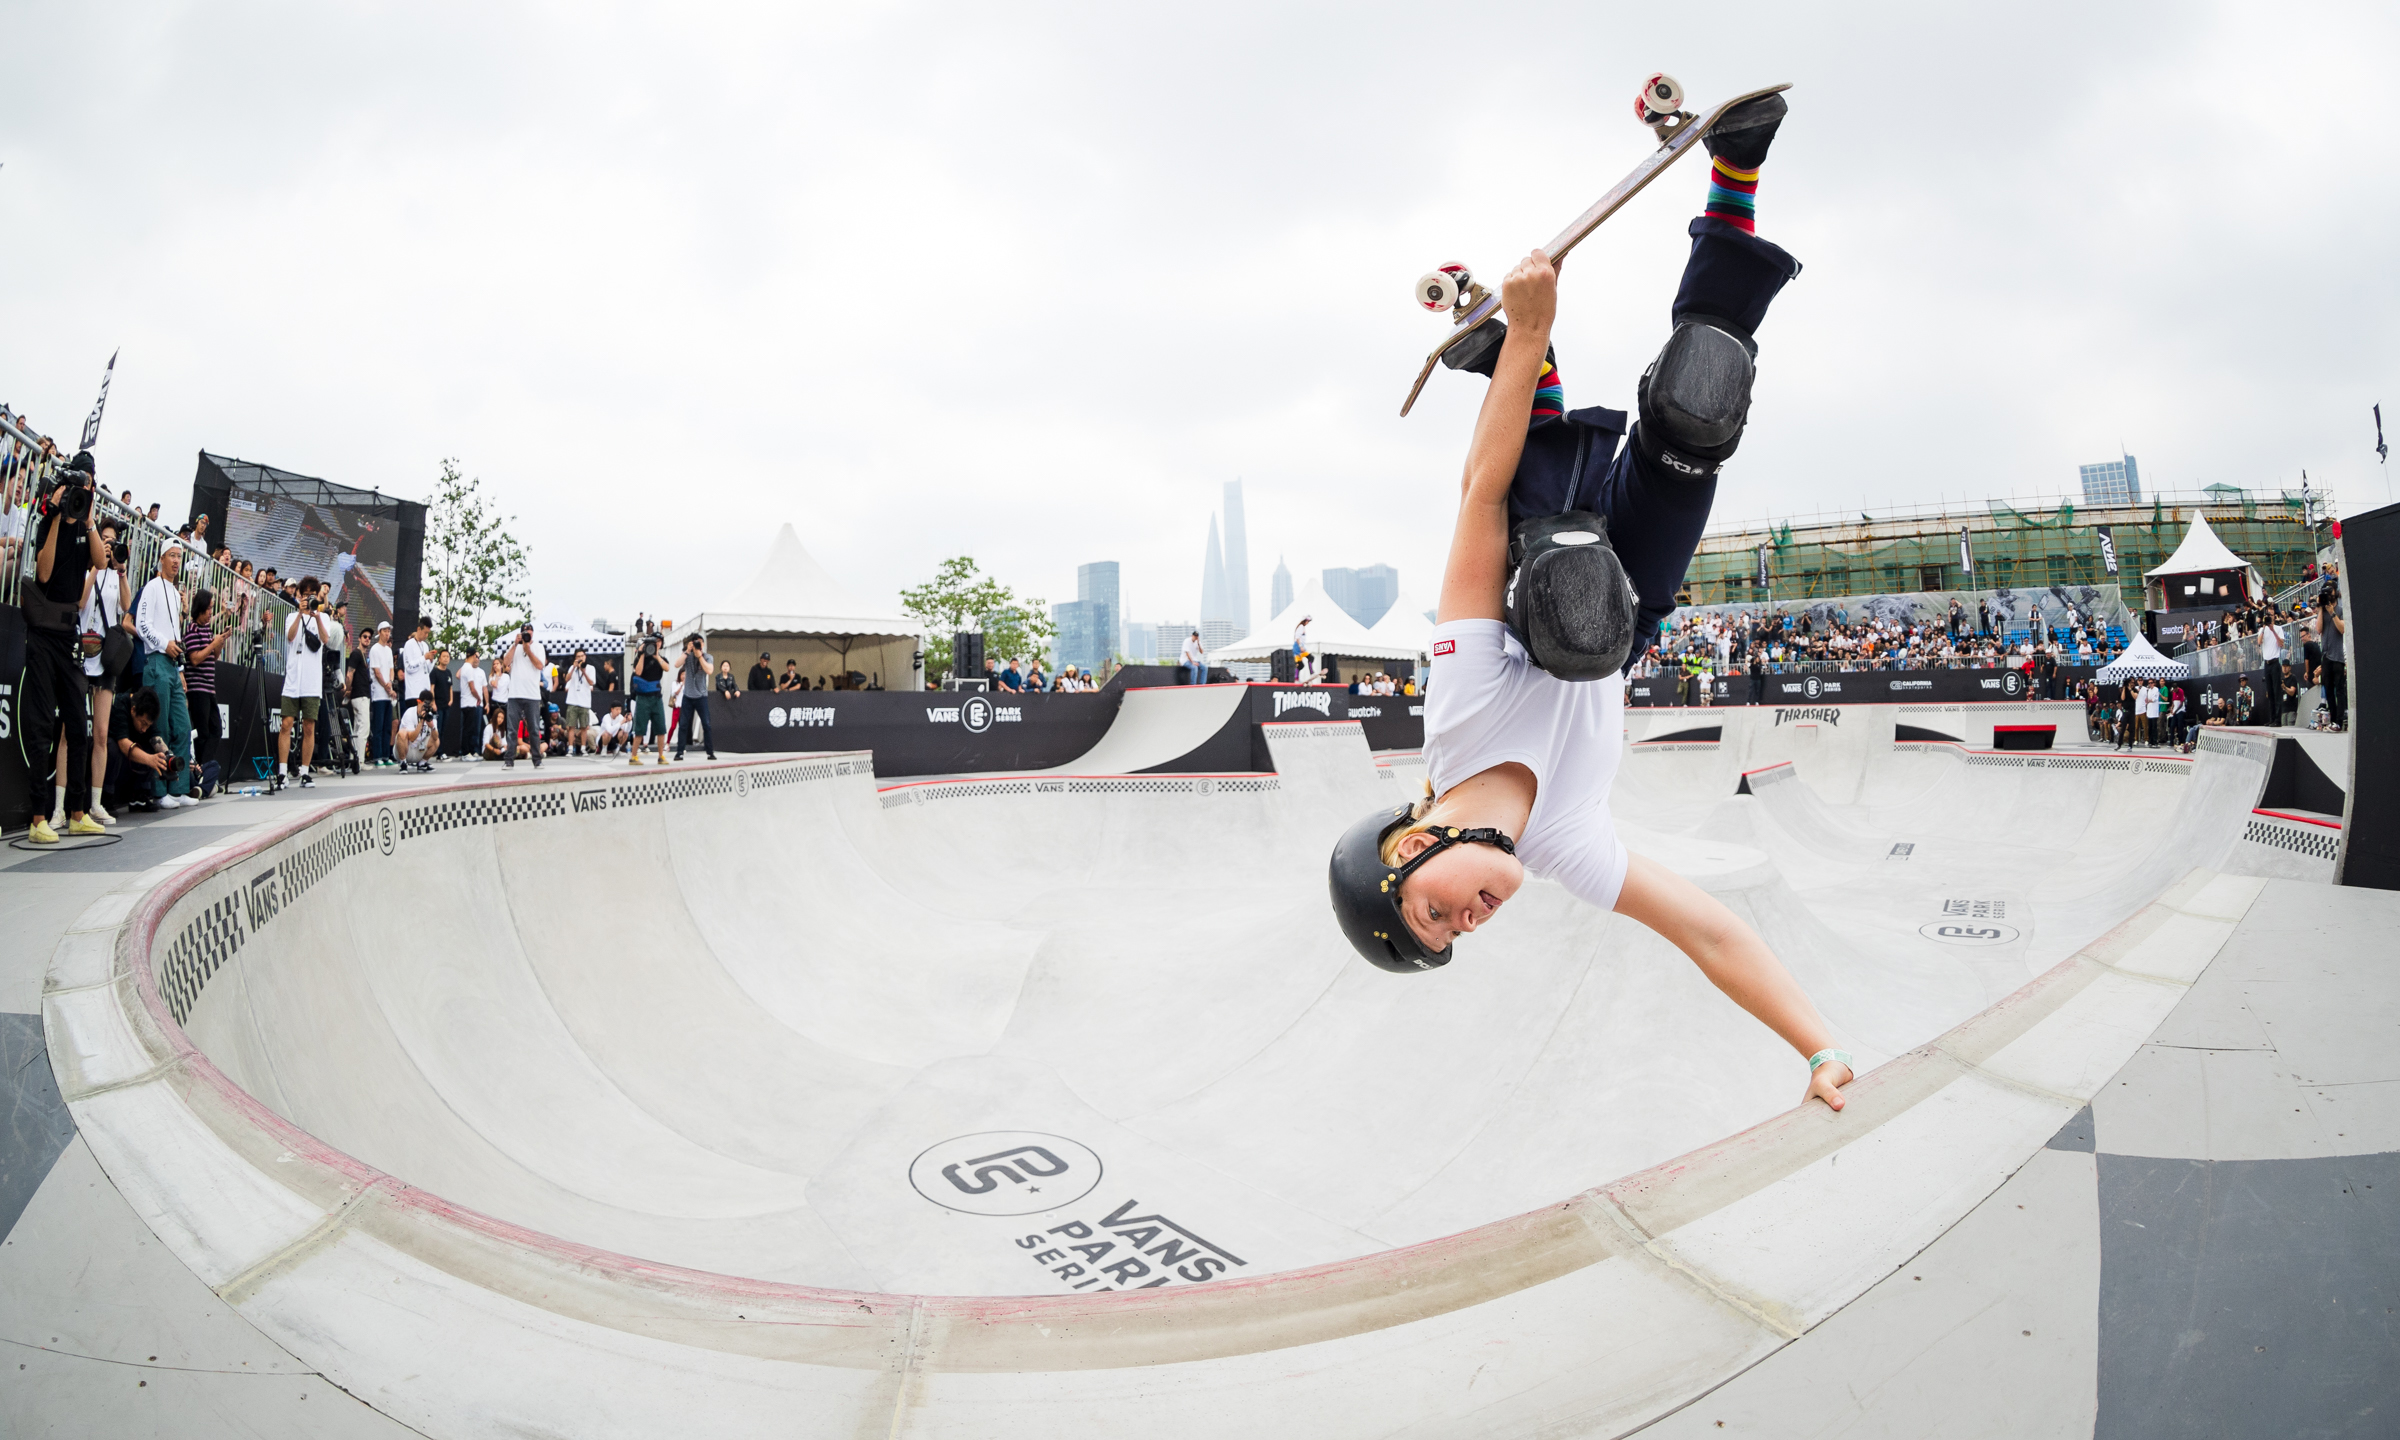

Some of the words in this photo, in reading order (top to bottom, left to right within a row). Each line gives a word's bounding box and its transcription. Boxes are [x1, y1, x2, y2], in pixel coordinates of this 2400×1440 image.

[543, 621, 574, 631] VANS
[1435, 641, 1453, 654] VANS
[1782, 683, 1802, 693] VANS
[1980, 679, 2001, 689] VANS
[1272, 691, 1331, 718] THRASHER
[789, 707, 835, 721] 腾讯体育
[926, 707, 960, 723] VANS
[995, 707, 1021, 715] PARK
[1775, 707, 1841, 728] THRASHER
[1309, 727, 1330, 737] VANS
[834, 762, 851, 776] VANS
[2027, 758, 2046, 768] VANS
[1035, 782, 1064, 792] VANS
[571, 789, 607, 813] VANS
[243, 867, 279, 933] VANS
[1942, 899, 1970, 917] VANS
[1972, 900, 1991, 918] PARK
[1993, 900, 2005, 919] SERIES
[1098, 1199, 1248, 1282] VANS
[1015, 1234, 1115, 1291] SERI
